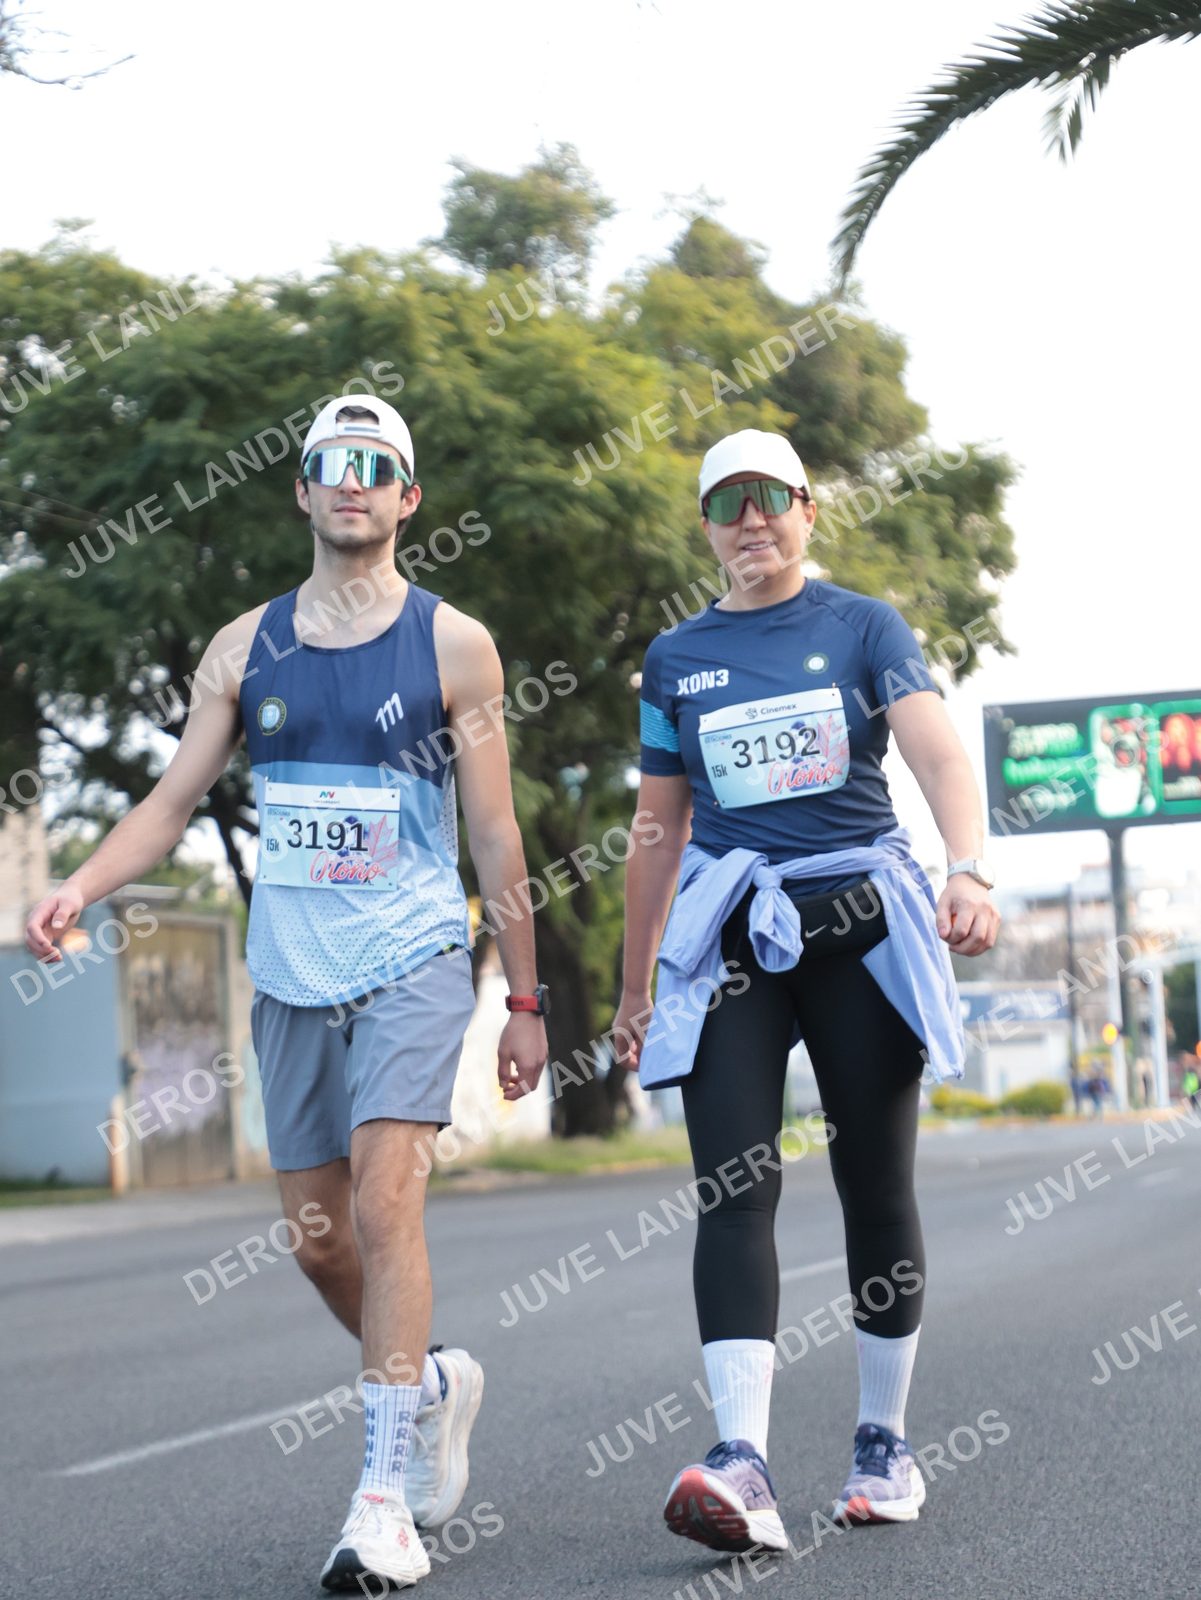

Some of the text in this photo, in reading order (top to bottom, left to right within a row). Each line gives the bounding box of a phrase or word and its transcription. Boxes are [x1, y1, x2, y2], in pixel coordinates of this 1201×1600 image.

[760, 703, 798, 716] Cinemex
[731, 726, 821, 769] 3192
[711, 764, 728, 779] 15k
[287, 818, 368, 852] 3191
[266, 838, 280, 852] 15k
